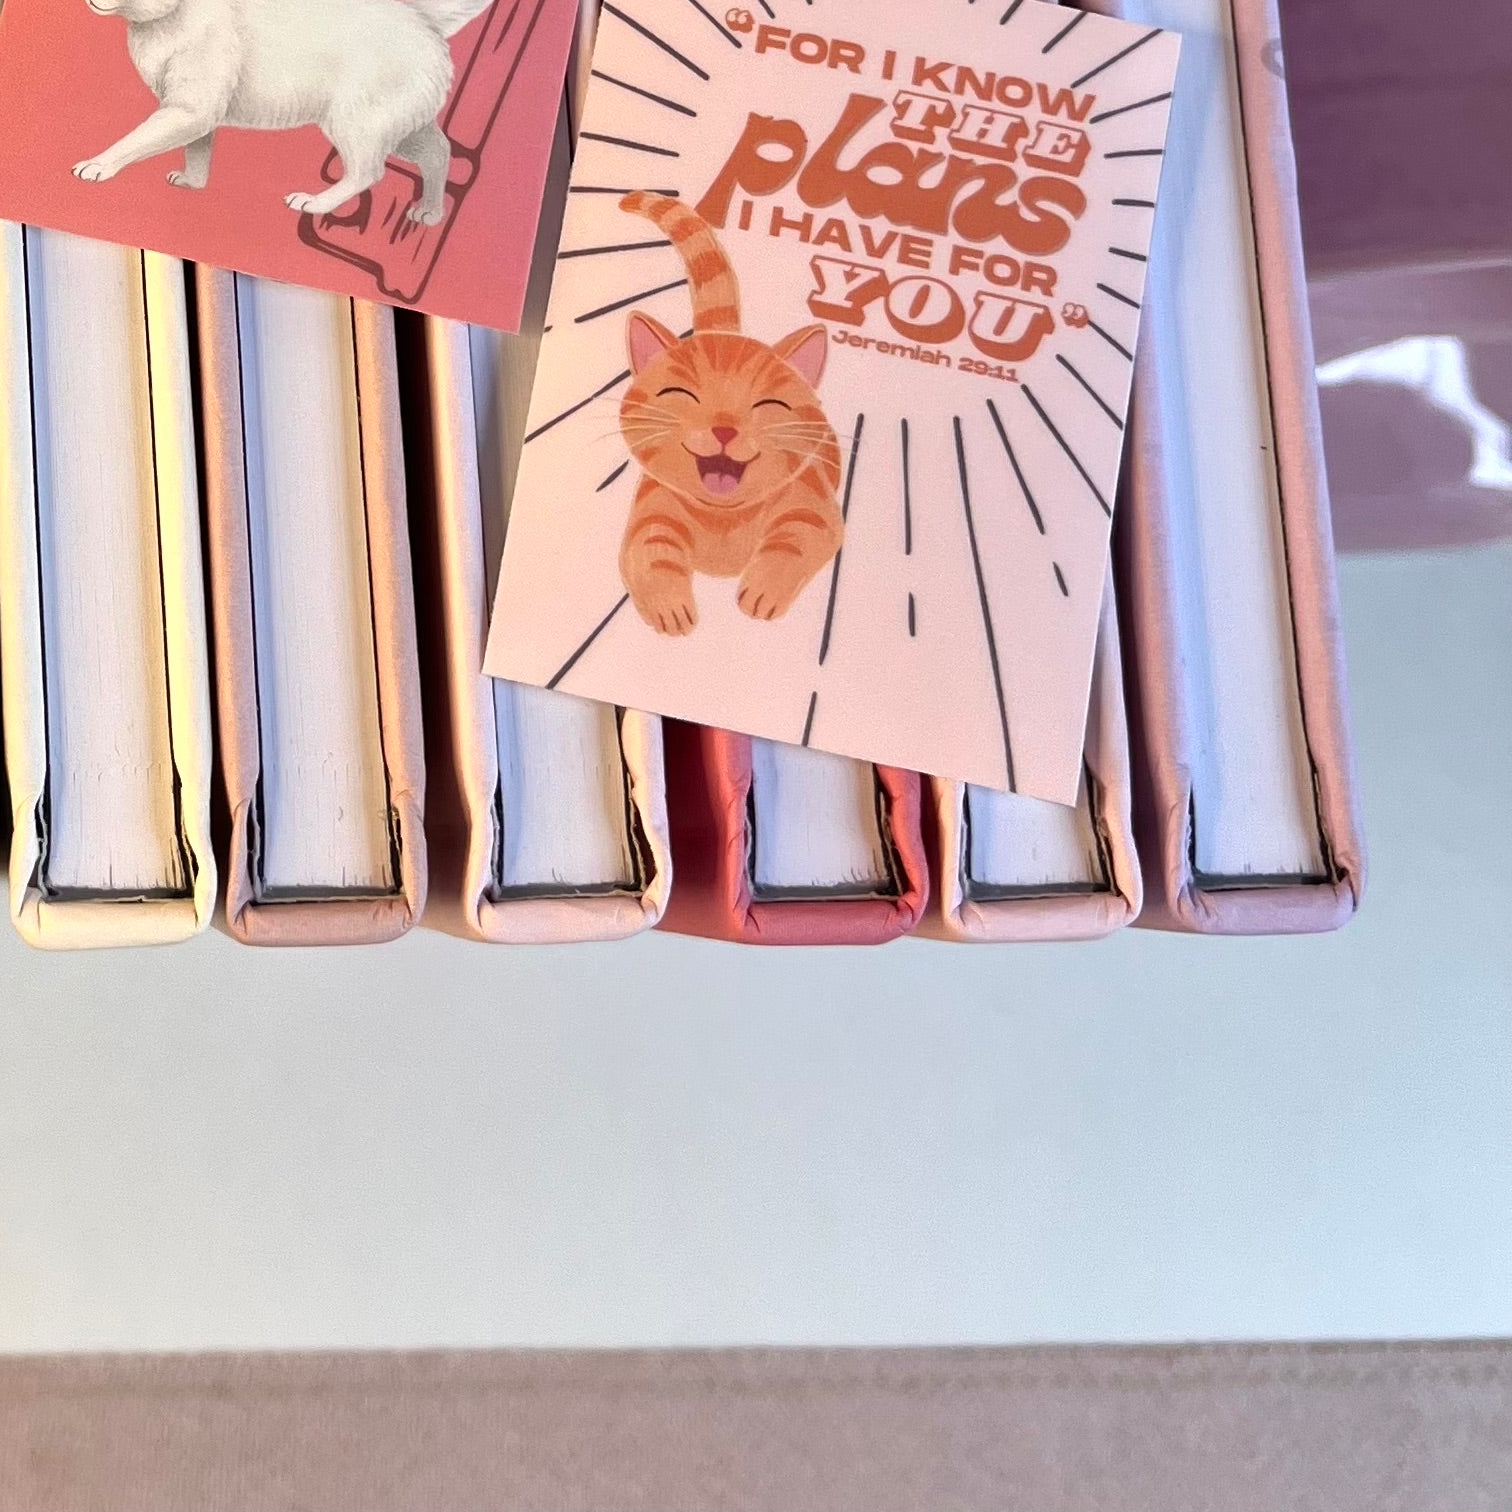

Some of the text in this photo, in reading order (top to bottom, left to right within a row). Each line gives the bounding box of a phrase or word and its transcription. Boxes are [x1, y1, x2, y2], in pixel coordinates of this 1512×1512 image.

[881, 50, 897, 80] I
[911, 56, 1097, 122] KNOW
[695, 93, 1087, 256] plans
[890, 90, 1091, 178] THE
[738, 200, 1058, 296] I HAVE FOR
[832, 330, 1019, 382] Jeremiah 29:11
